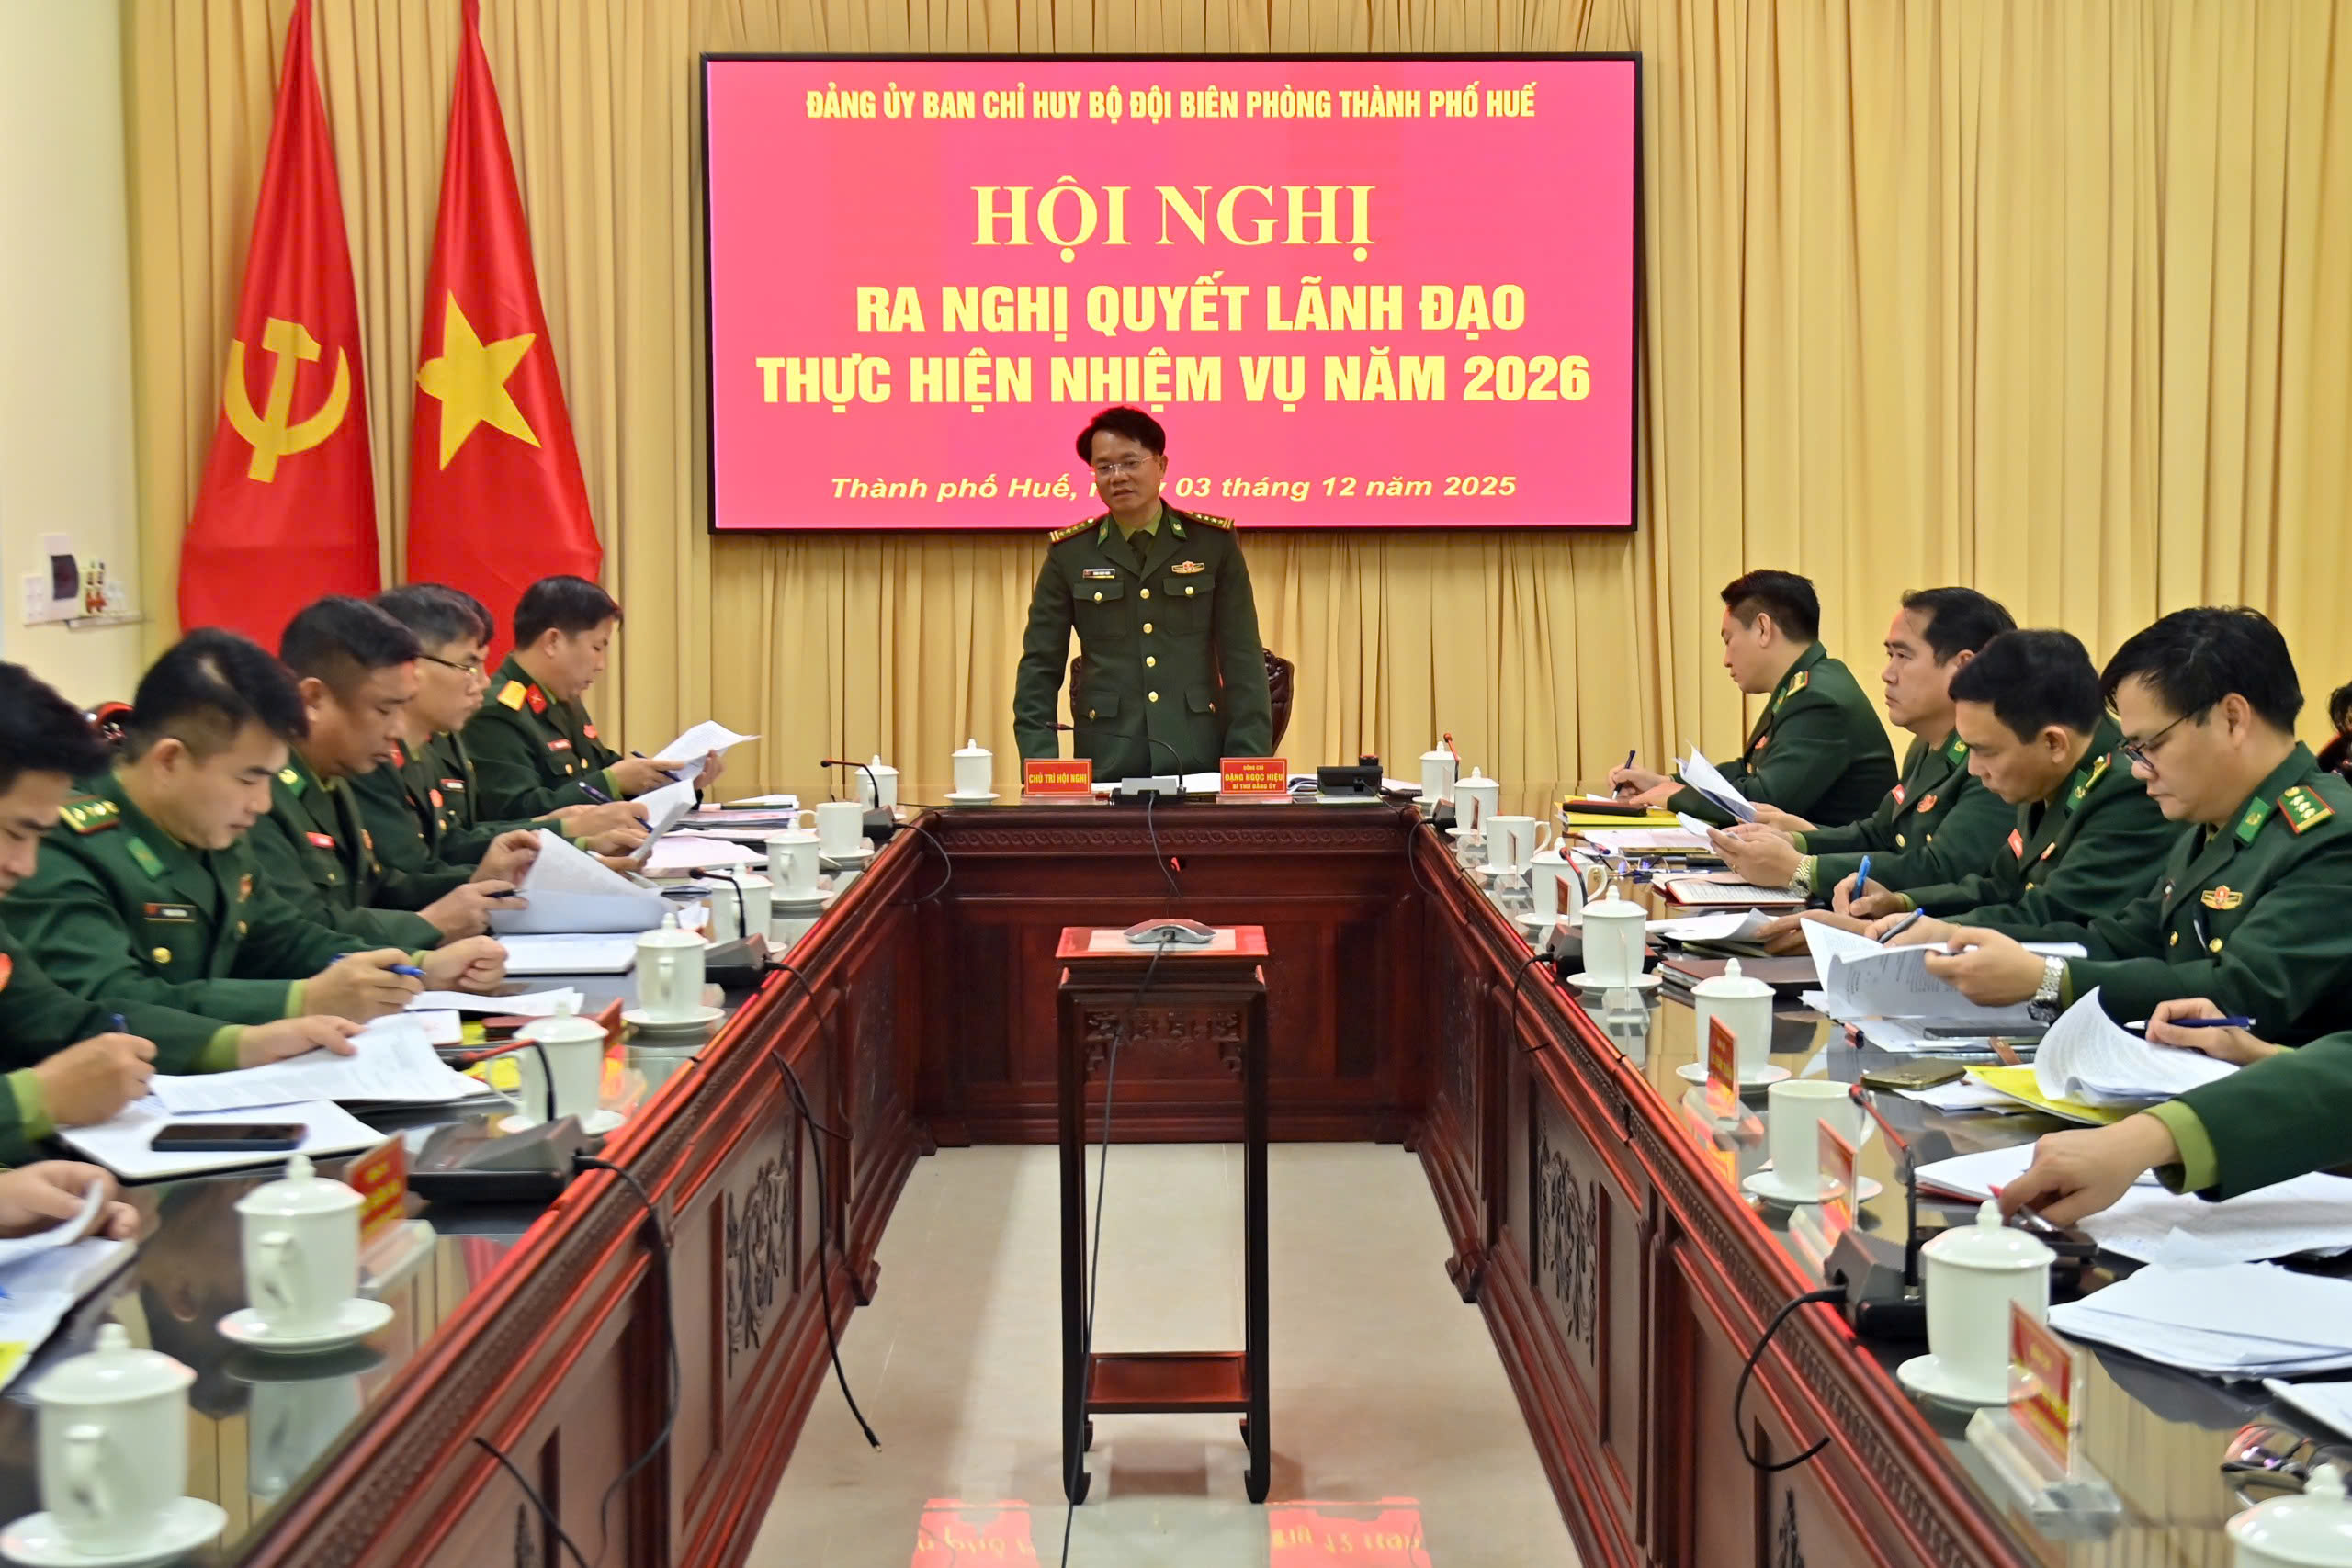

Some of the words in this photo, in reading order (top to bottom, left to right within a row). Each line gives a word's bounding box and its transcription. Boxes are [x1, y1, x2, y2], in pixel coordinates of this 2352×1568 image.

[806, 82, 876, 118] ĐẢNG
[883, 82, 916, 118] ỦY
[922, 91, 976, 118] BAN
[982, 82, 1026, 118] CHỈ
[1032, 91, 1082, 118] HUY
[1088, 85, 1123, 124] BỘ
[1129, 85, 1172, 124] ĐỘI
[1179, 85, 1238, 118] BIÊN
[1246, 85, 1332, 118] PHÒNG
[1338, 85, 1421, 118] THÀNH
[1429, 81, 1480, 118] PHỐ
[1486, 81, 1537, 118] HUẾ
[970, 176, 1131, 263] HỘI
[1155, 185, 1374, 263] NGHỊ
[856, 287, 926, 333] RA
[942, 286, 1068, 336] NGHỊ
[1086, 271, 1250, 337] QUYẾT
[1266, 276, 1403, 332] LÃNH
[1419, 285, 1525, 336] ĐẠO
[755, 353, 891, 412] THỰC
[910, 347, 1032, 412] HIỆN
[1050, 347, 1222, 412] NHIỆM
[1238, 355, 1306, 412] VỤ
[1324, 346, 1446, 402] NĂM
[1463, 355, 1590, 401] 2026
[831, 477, 928, 499] Thành
[935, 473, 999, 502] phố
[1007, 472, 1077, 501] Huế,
[1175, 477, 1212, 498] 03
[1221, 476, 1311, 502] tháng
[1322, 476, 1357, 497] 12
[1365, 476, 1433, 497] năm
[1443, 475, 1517, 496] 2025
[1029, 772, 1044, 784] CHỦ
[1045, 772, 1056, 784] TRÌ
[1057, 772, 1069, 785] HỘI
[1070, 773, 1087, 785] NGHỊ
[1245, 773, 1265, 783] NGỌC
